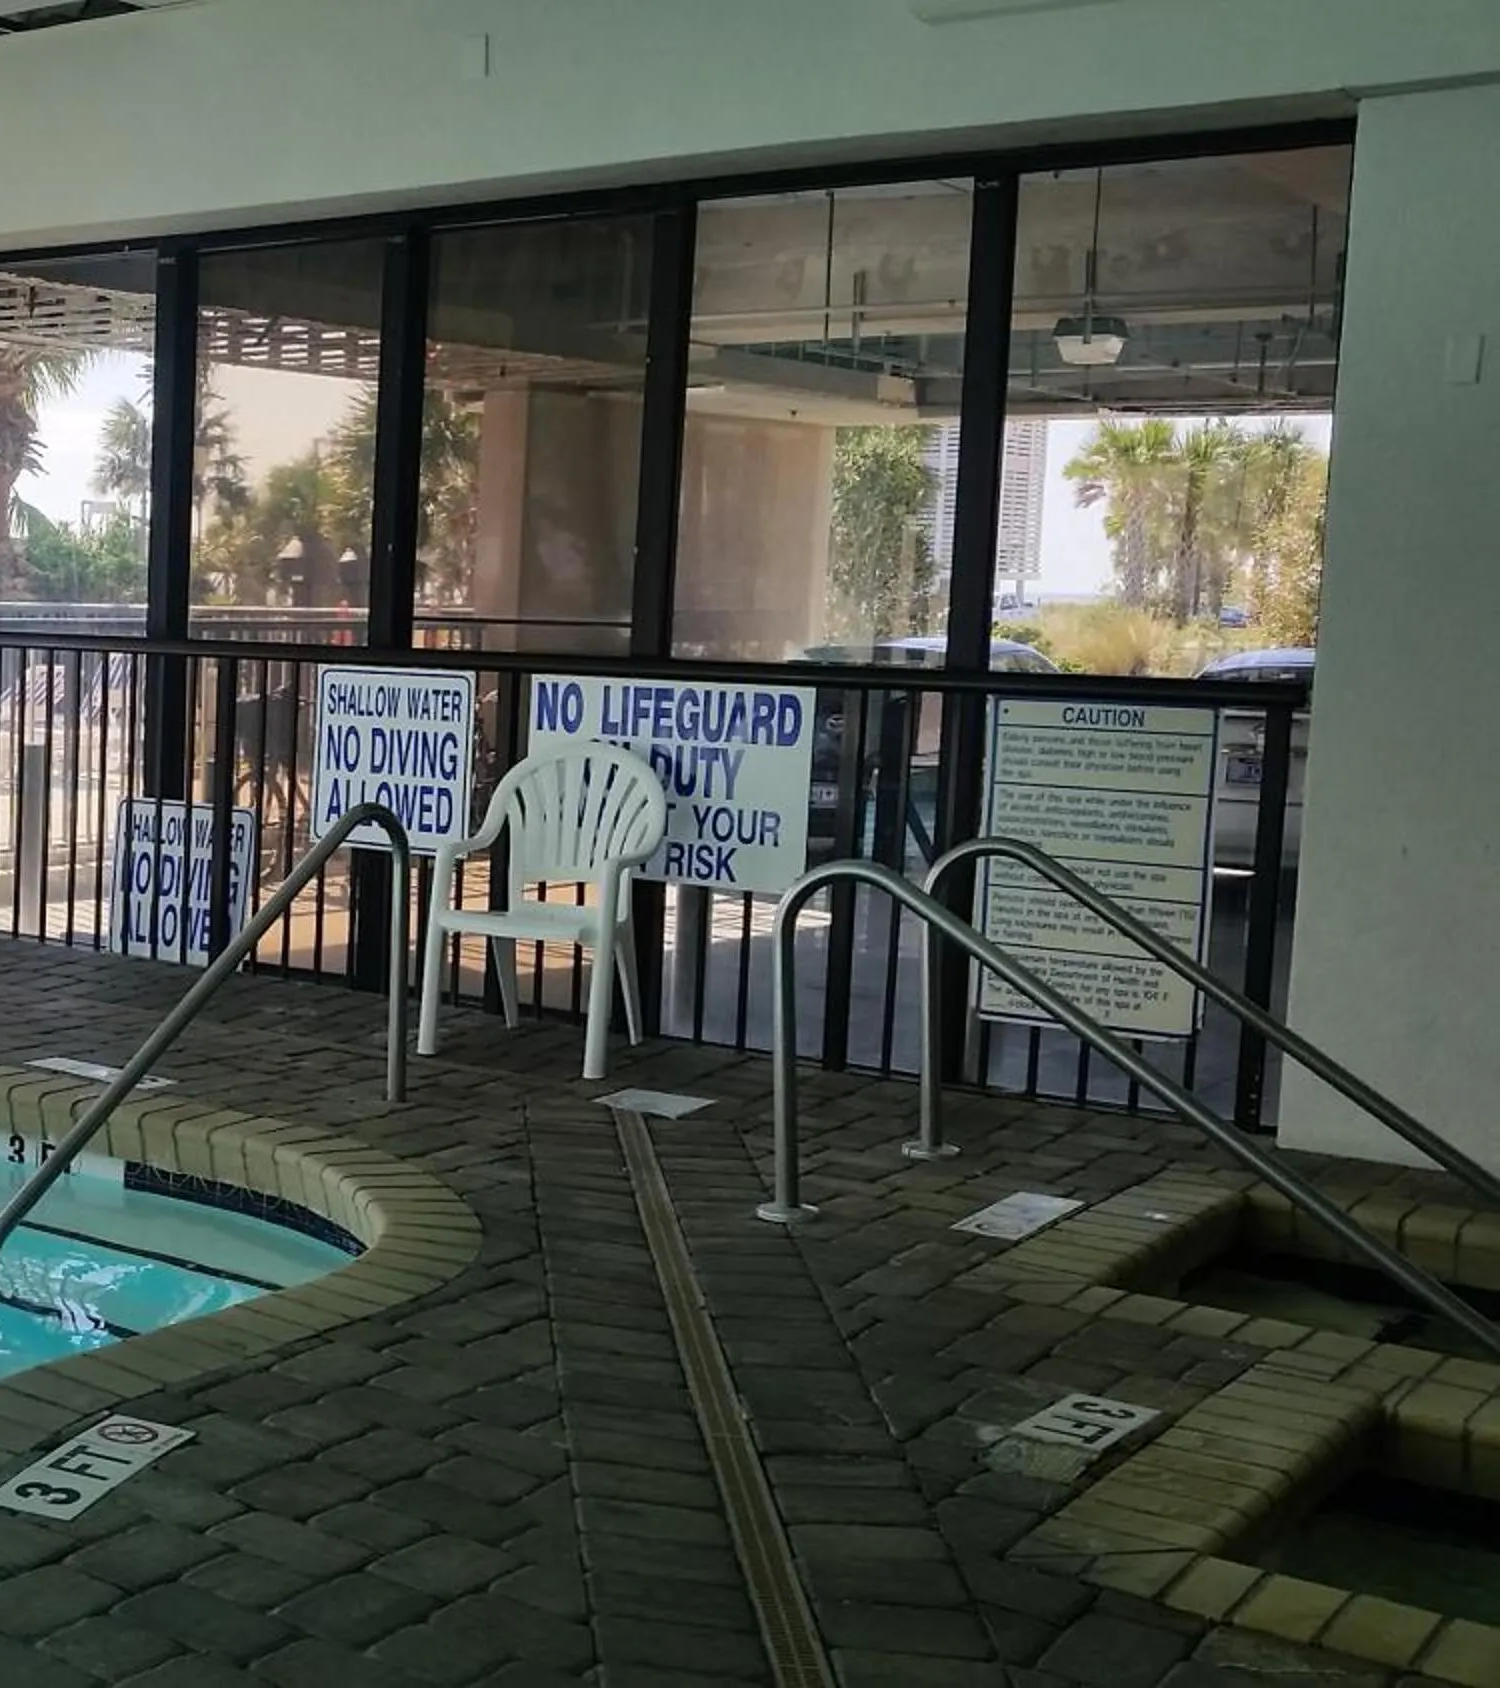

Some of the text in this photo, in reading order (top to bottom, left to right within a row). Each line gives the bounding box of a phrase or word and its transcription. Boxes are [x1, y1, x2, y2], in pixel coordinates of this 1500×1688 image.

[328, 683, 462, 722] SHALLOW WATER
[536, 681, 803, 746] NO LIFEGUARD
[1062, 707, 1146, 727] CAUTION
[326, 724, 458, 781] NO DIVING
[650, 744, 747, 800] DUTY
[692, 805, 782, 848] YOUR
[159, 854, 239, 904] DIVIG
[664, 841, 738, 883] RISK
[8, 1134, 25, 1165] 3
[1033, 1400, 1136, 1444] 3 FT
[15, 1444, 132, 1505] 3 FT
